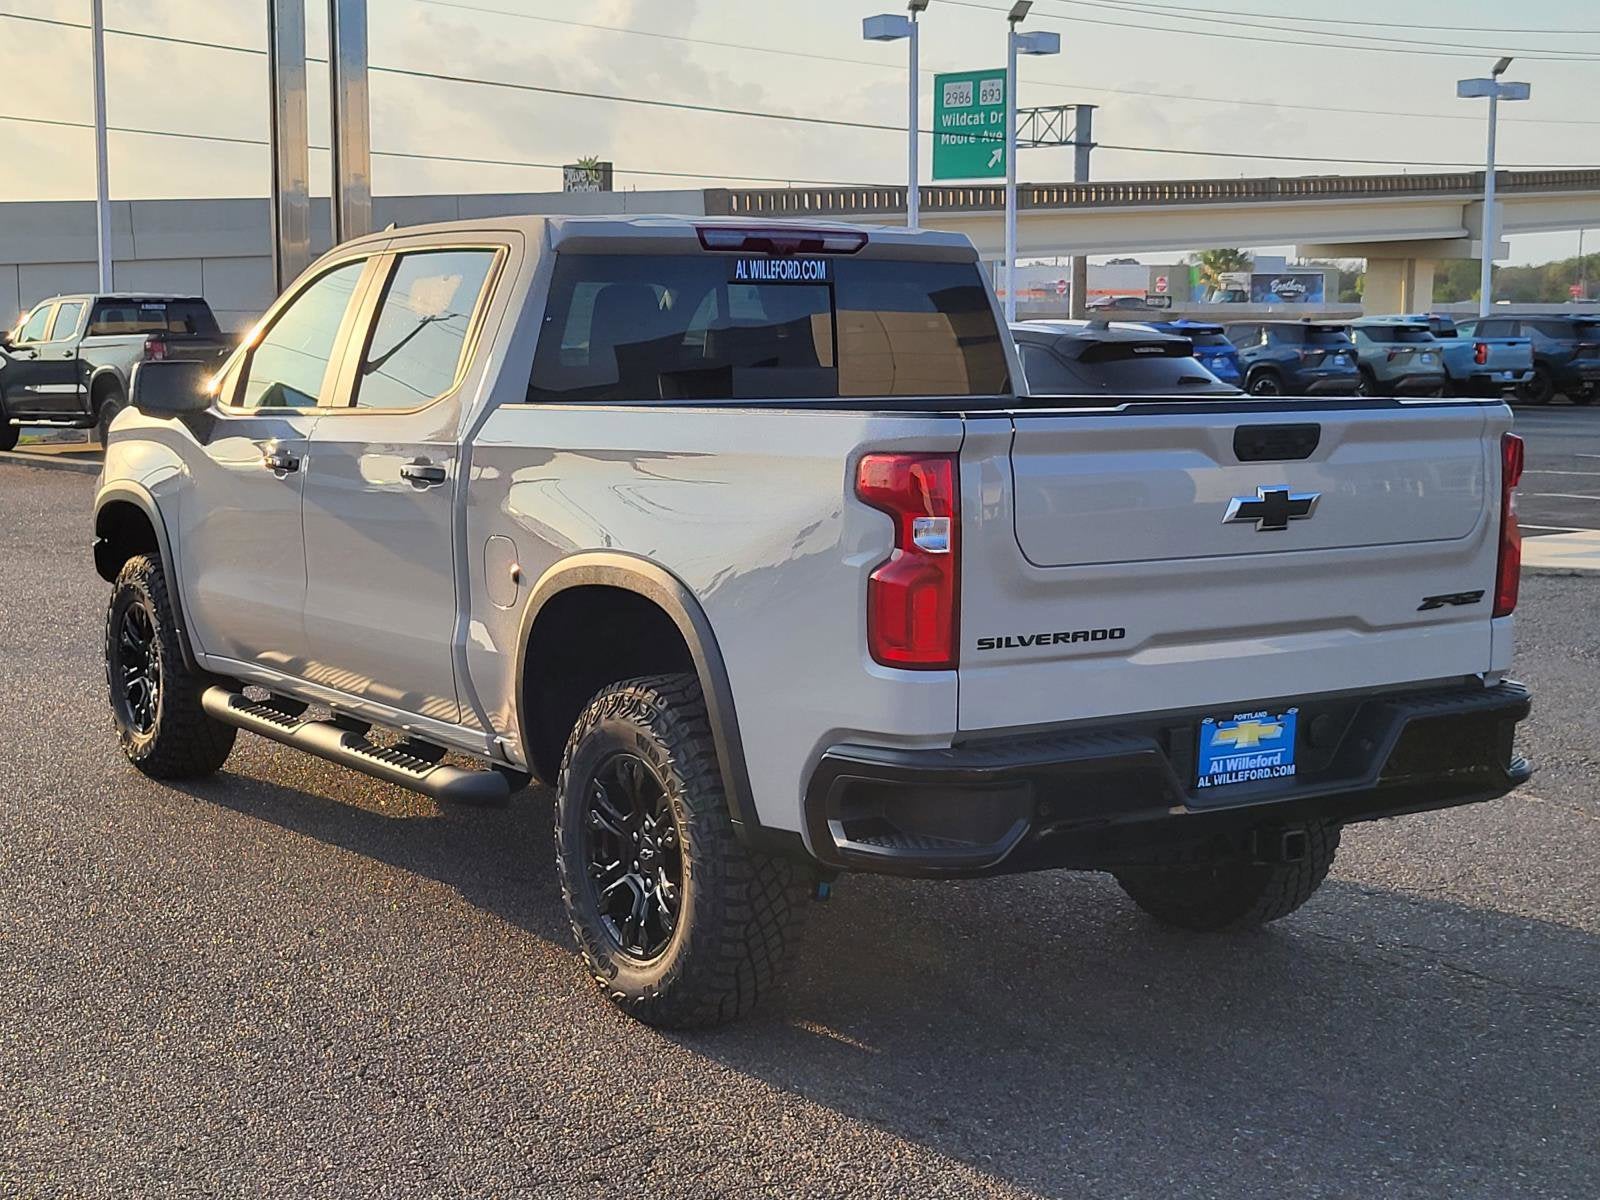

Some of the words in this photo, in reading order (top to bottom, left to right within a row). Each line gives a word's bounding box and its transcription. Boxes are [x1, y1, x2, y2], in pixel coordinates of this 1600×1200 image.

[945, 91, 971, 105] 2986
[981, 88, 1001, 102] 893
[942, 111, 985, 127] Wildcat
[990, 111, 1004, 123] Dr
[941, 132, 977, 144] Moore
[981, 130, 1003, 142] Ave
[735, 259, 748, 279] AL
[749, 259, 826, 280] WILLEFORD.COM
[977, 627, 1126, 650] SILVERADO
[1233, 711, 1268, 721] PORTLAND
[1209, 759, 1223, 774] Al
[1226, 752, 1281, 772] Willeford
[1197, 775, 1211, 788] AL
[1213, 764, 1296, 785] WILLEFORD.COM
